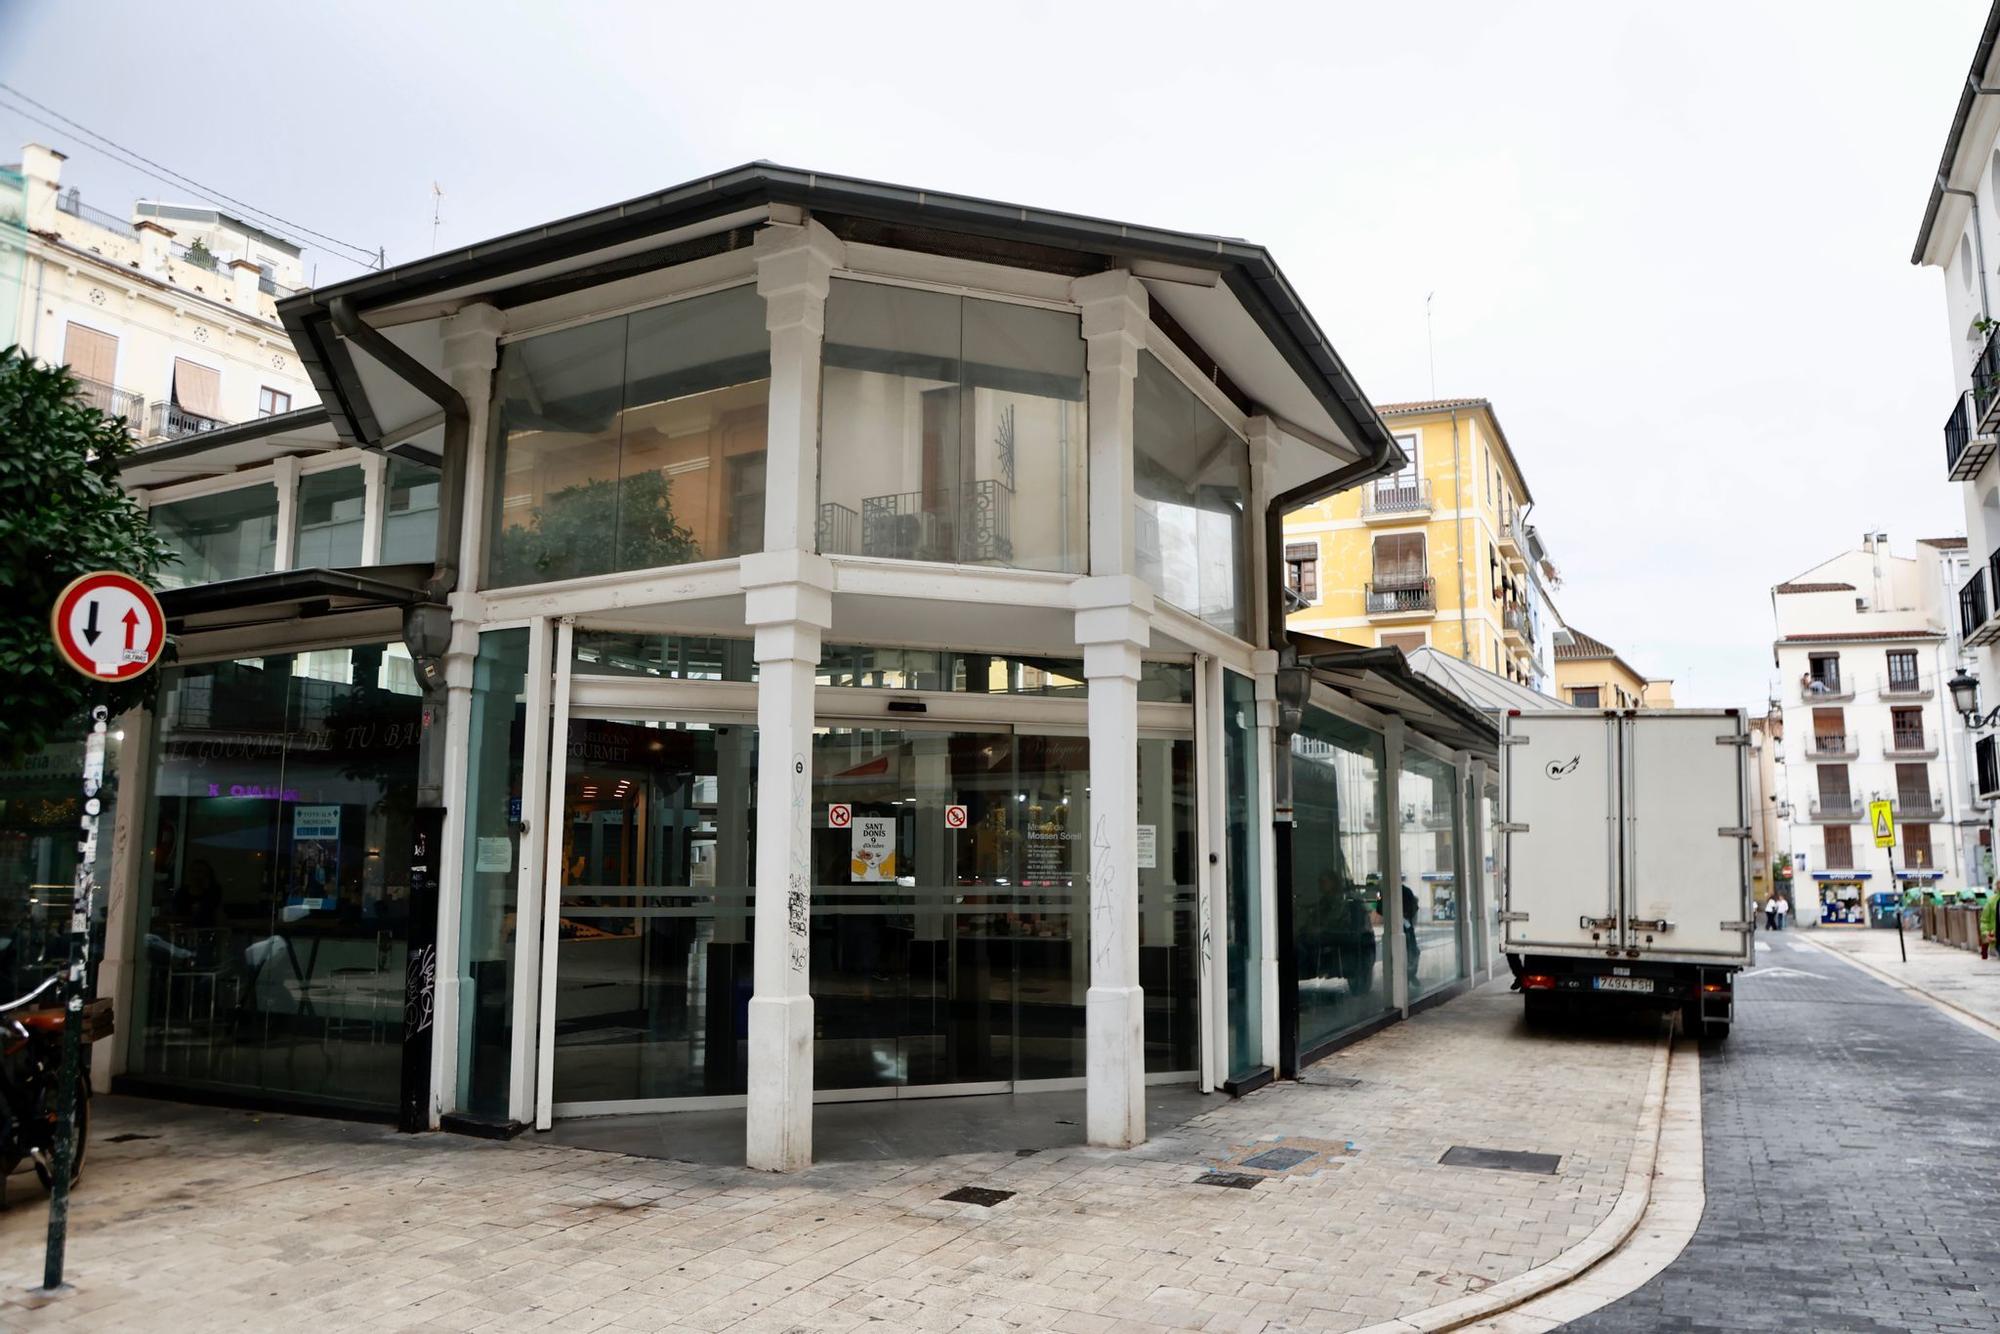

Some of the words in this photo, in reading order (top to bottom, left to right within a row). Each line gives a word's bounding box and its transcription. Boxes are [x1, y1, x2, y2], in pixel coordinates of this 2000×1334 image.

[198, 732, 296, 768] GOURMET
[346, 723, 376, 750] TU
[865, 822, 883, 830] SANT
